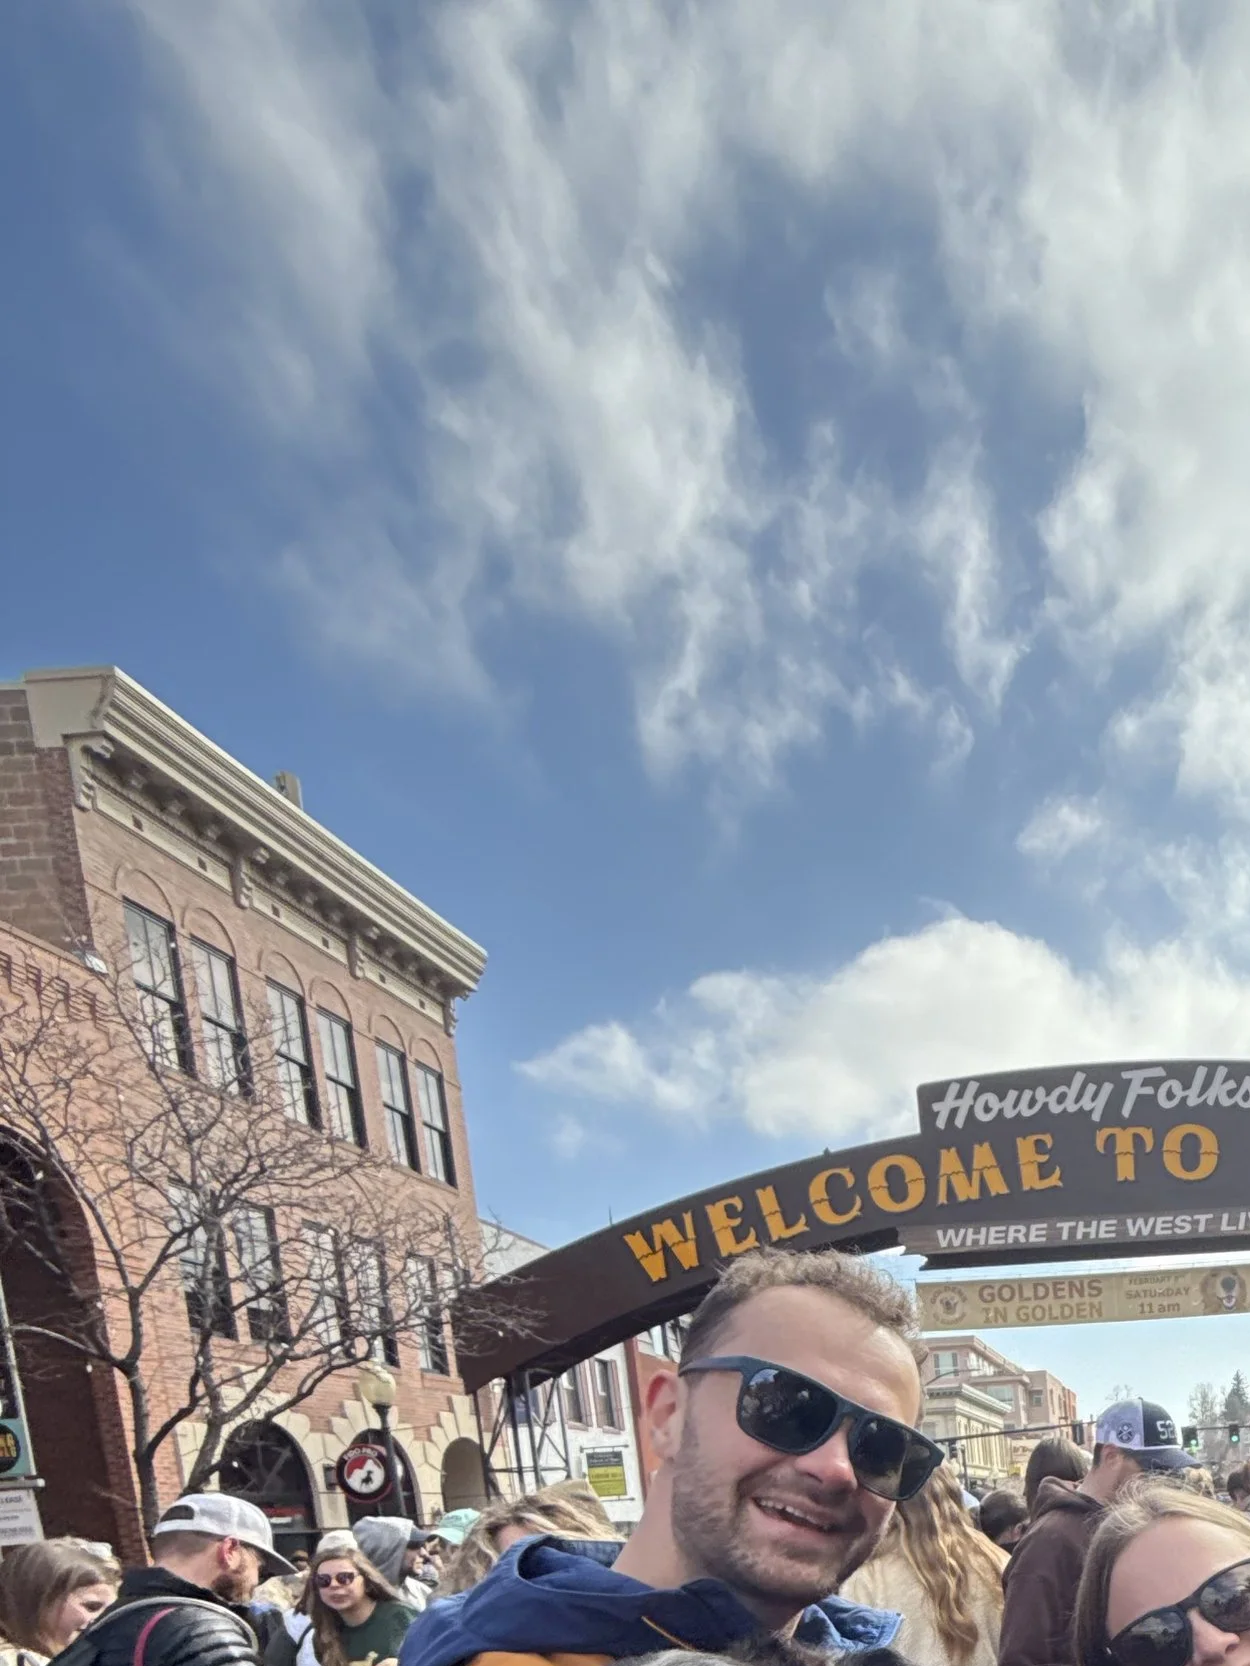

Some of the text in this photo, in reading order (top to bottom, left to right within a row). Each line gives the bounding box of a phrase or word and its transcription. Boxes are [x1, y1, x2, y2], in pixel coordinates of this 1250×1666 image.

[932, 1071, 1114, 1130] Howdy
[623, 1133, 1063, 1282] WELCOME
[1095, 1123, 1220, 1182] TO
[936, 1223, 1046, 1247] WHERE
[1056, 1219, 1117, 1241] THE
[1126, 1213, 1213, 1238] WEST
[978, 1278, 1103, 1304] GOLDENS
[1125, 1286, 1190, 1300] SATURDAY
[982, 1306, 1008, 1324] IN
[1015, 1302, 1103, 1324] GOLDEN
[1138, 1302, 1181, 1314] 11 am
